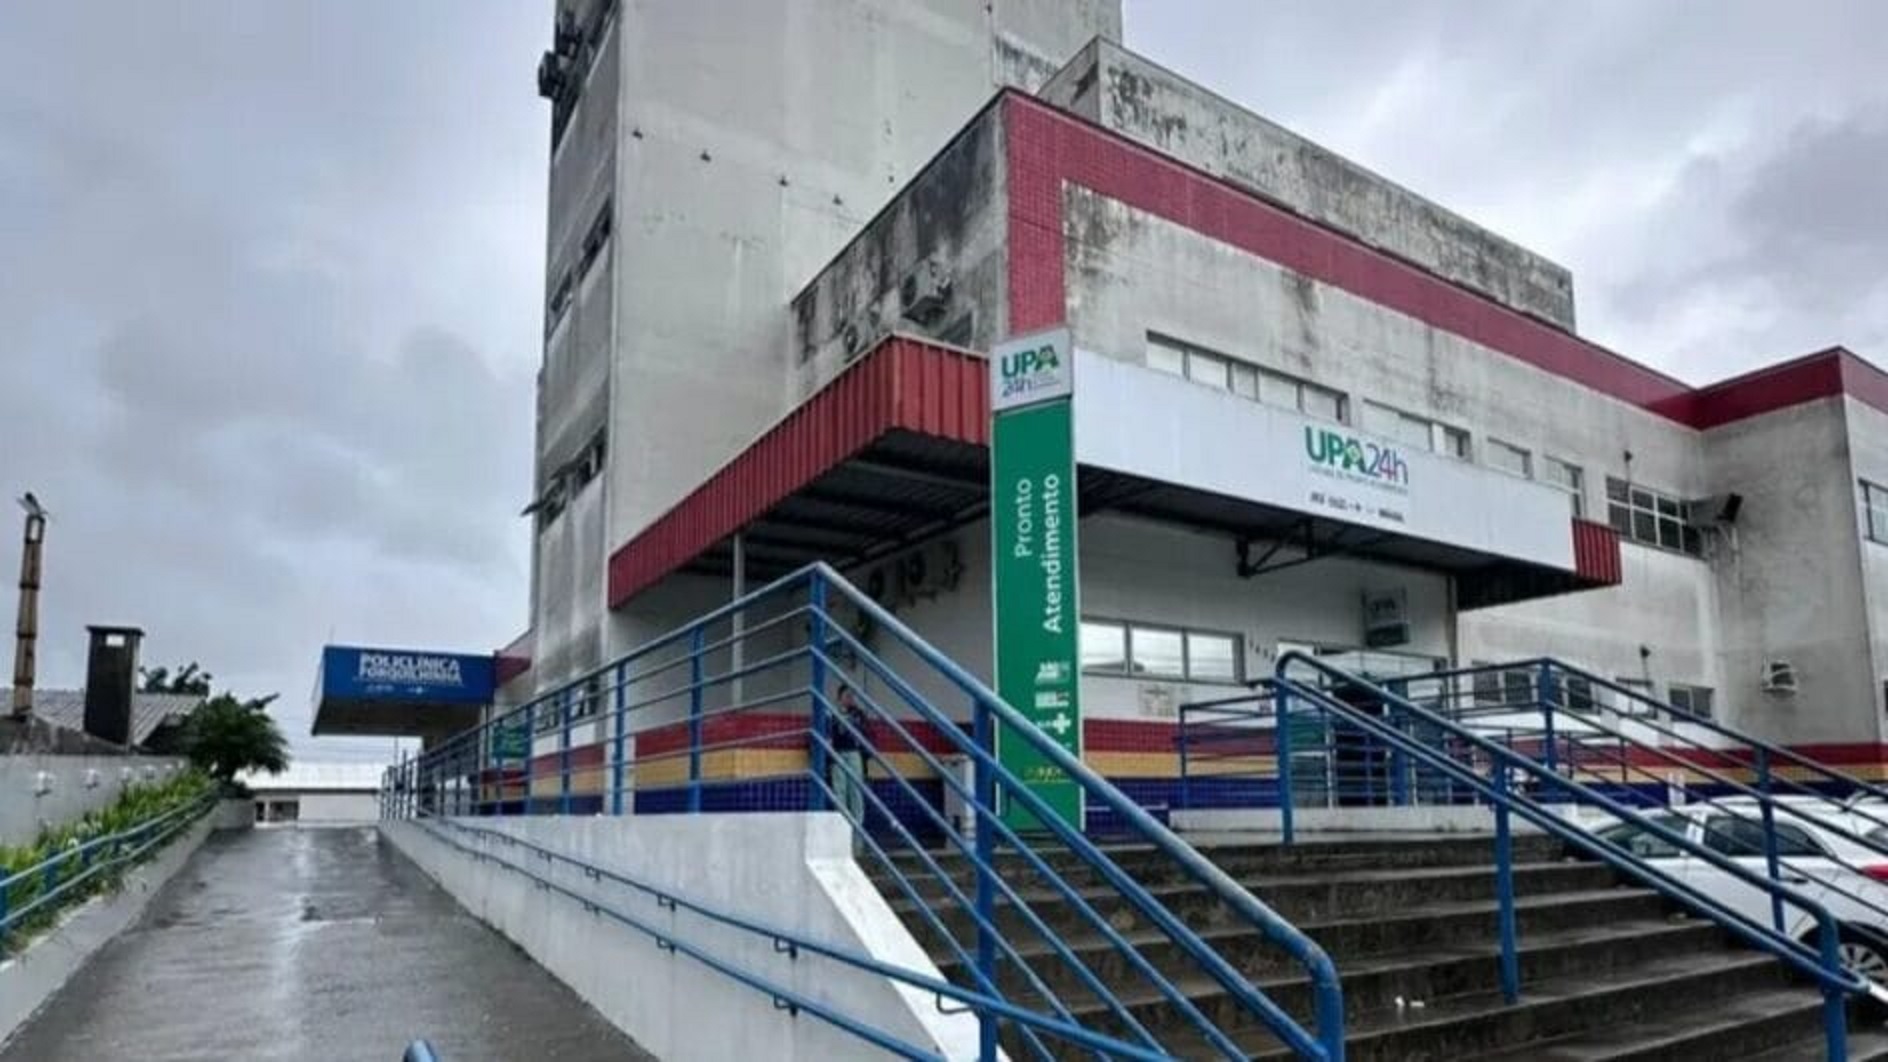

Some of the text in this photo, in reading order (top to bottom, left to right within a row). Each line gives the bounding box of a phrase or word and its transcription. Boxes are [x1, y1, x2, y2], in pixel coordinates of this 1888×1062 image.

[1002, 345, 1059, 378] UPA
[1014, 478, 1033, 557] Pronto
[1041, 473, 1062, 633] Atendimento
[358, 653, 462, 673] POLICLÍNICA
